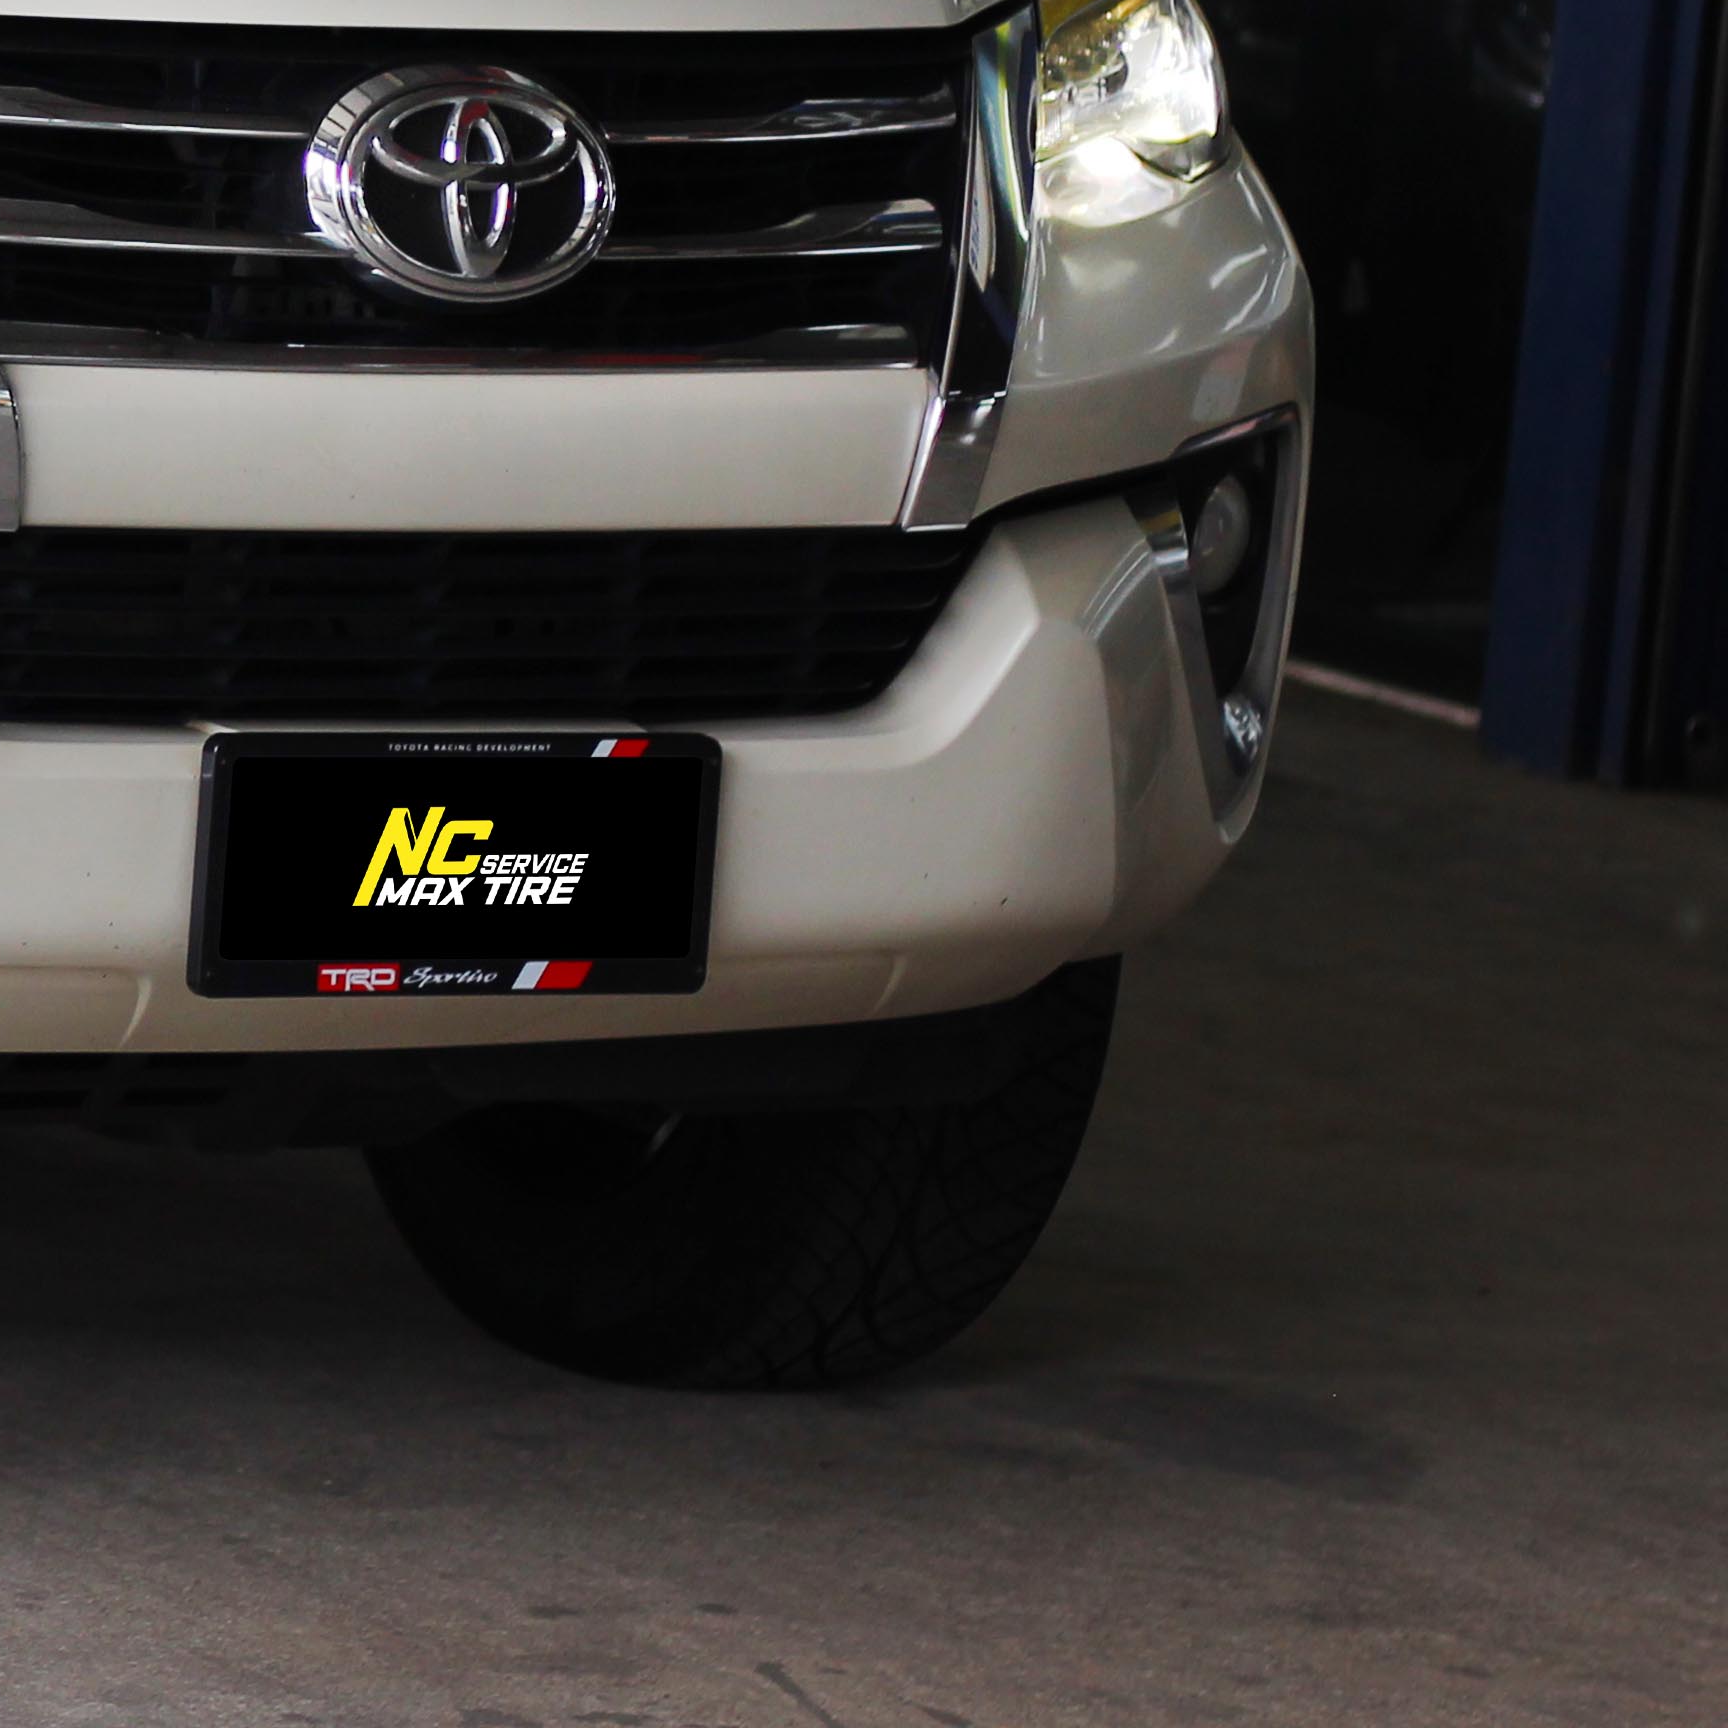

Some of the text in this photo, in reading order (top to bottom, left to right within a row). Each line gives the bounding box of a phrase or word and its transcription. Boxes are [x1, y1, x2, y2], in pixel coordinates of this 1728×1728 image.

[388, 743, 551, 752] TOYOTA RACING DEVELOPMENT
[320, 967, 397, 992] TRD
